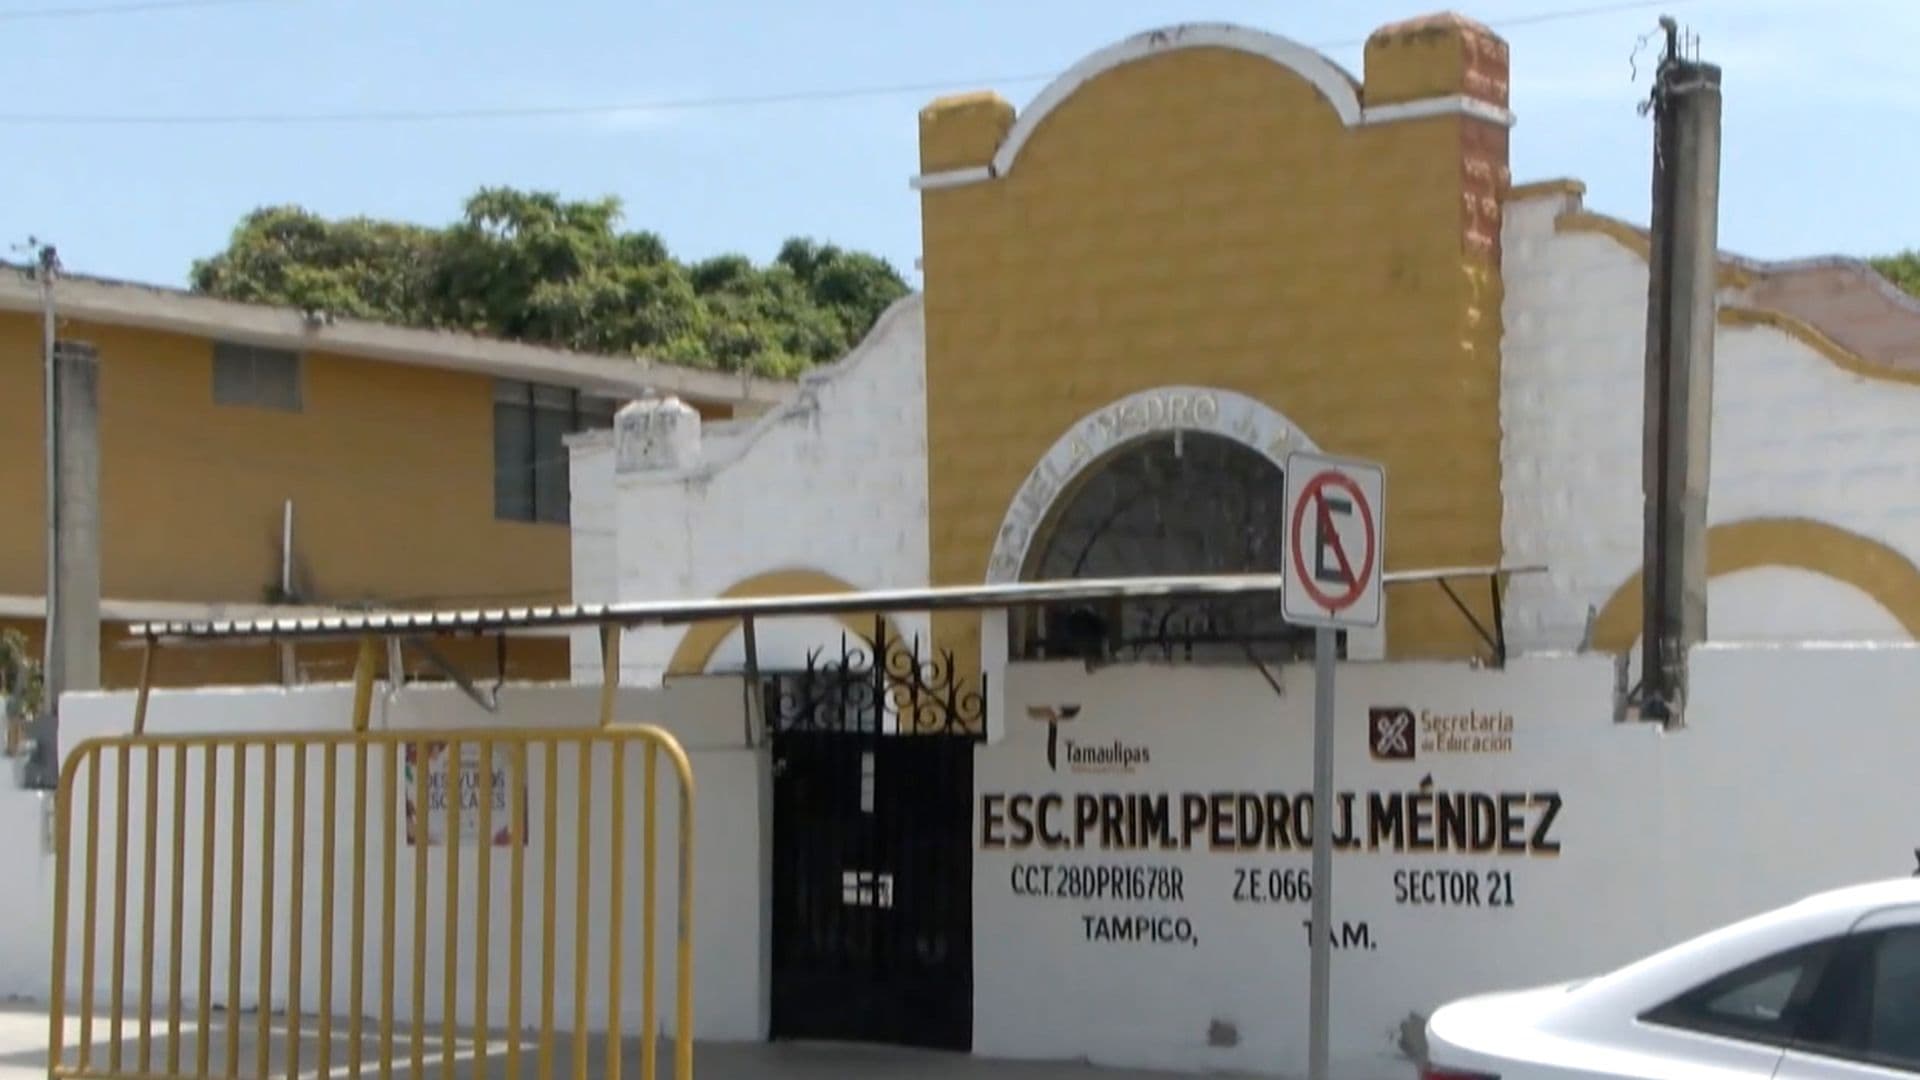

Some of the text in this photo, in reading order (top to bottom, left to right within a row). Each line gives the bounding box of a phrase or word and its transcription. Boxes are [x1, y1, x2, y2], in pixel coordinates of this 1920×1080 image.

[1065, 739, 1150, 768] Tamaulipas
[1394, 869, 1481, 907] SECTOR
[1487, 871, 1515, 908] 21
[1083, 915, 1198, 948] TAMPICO,
